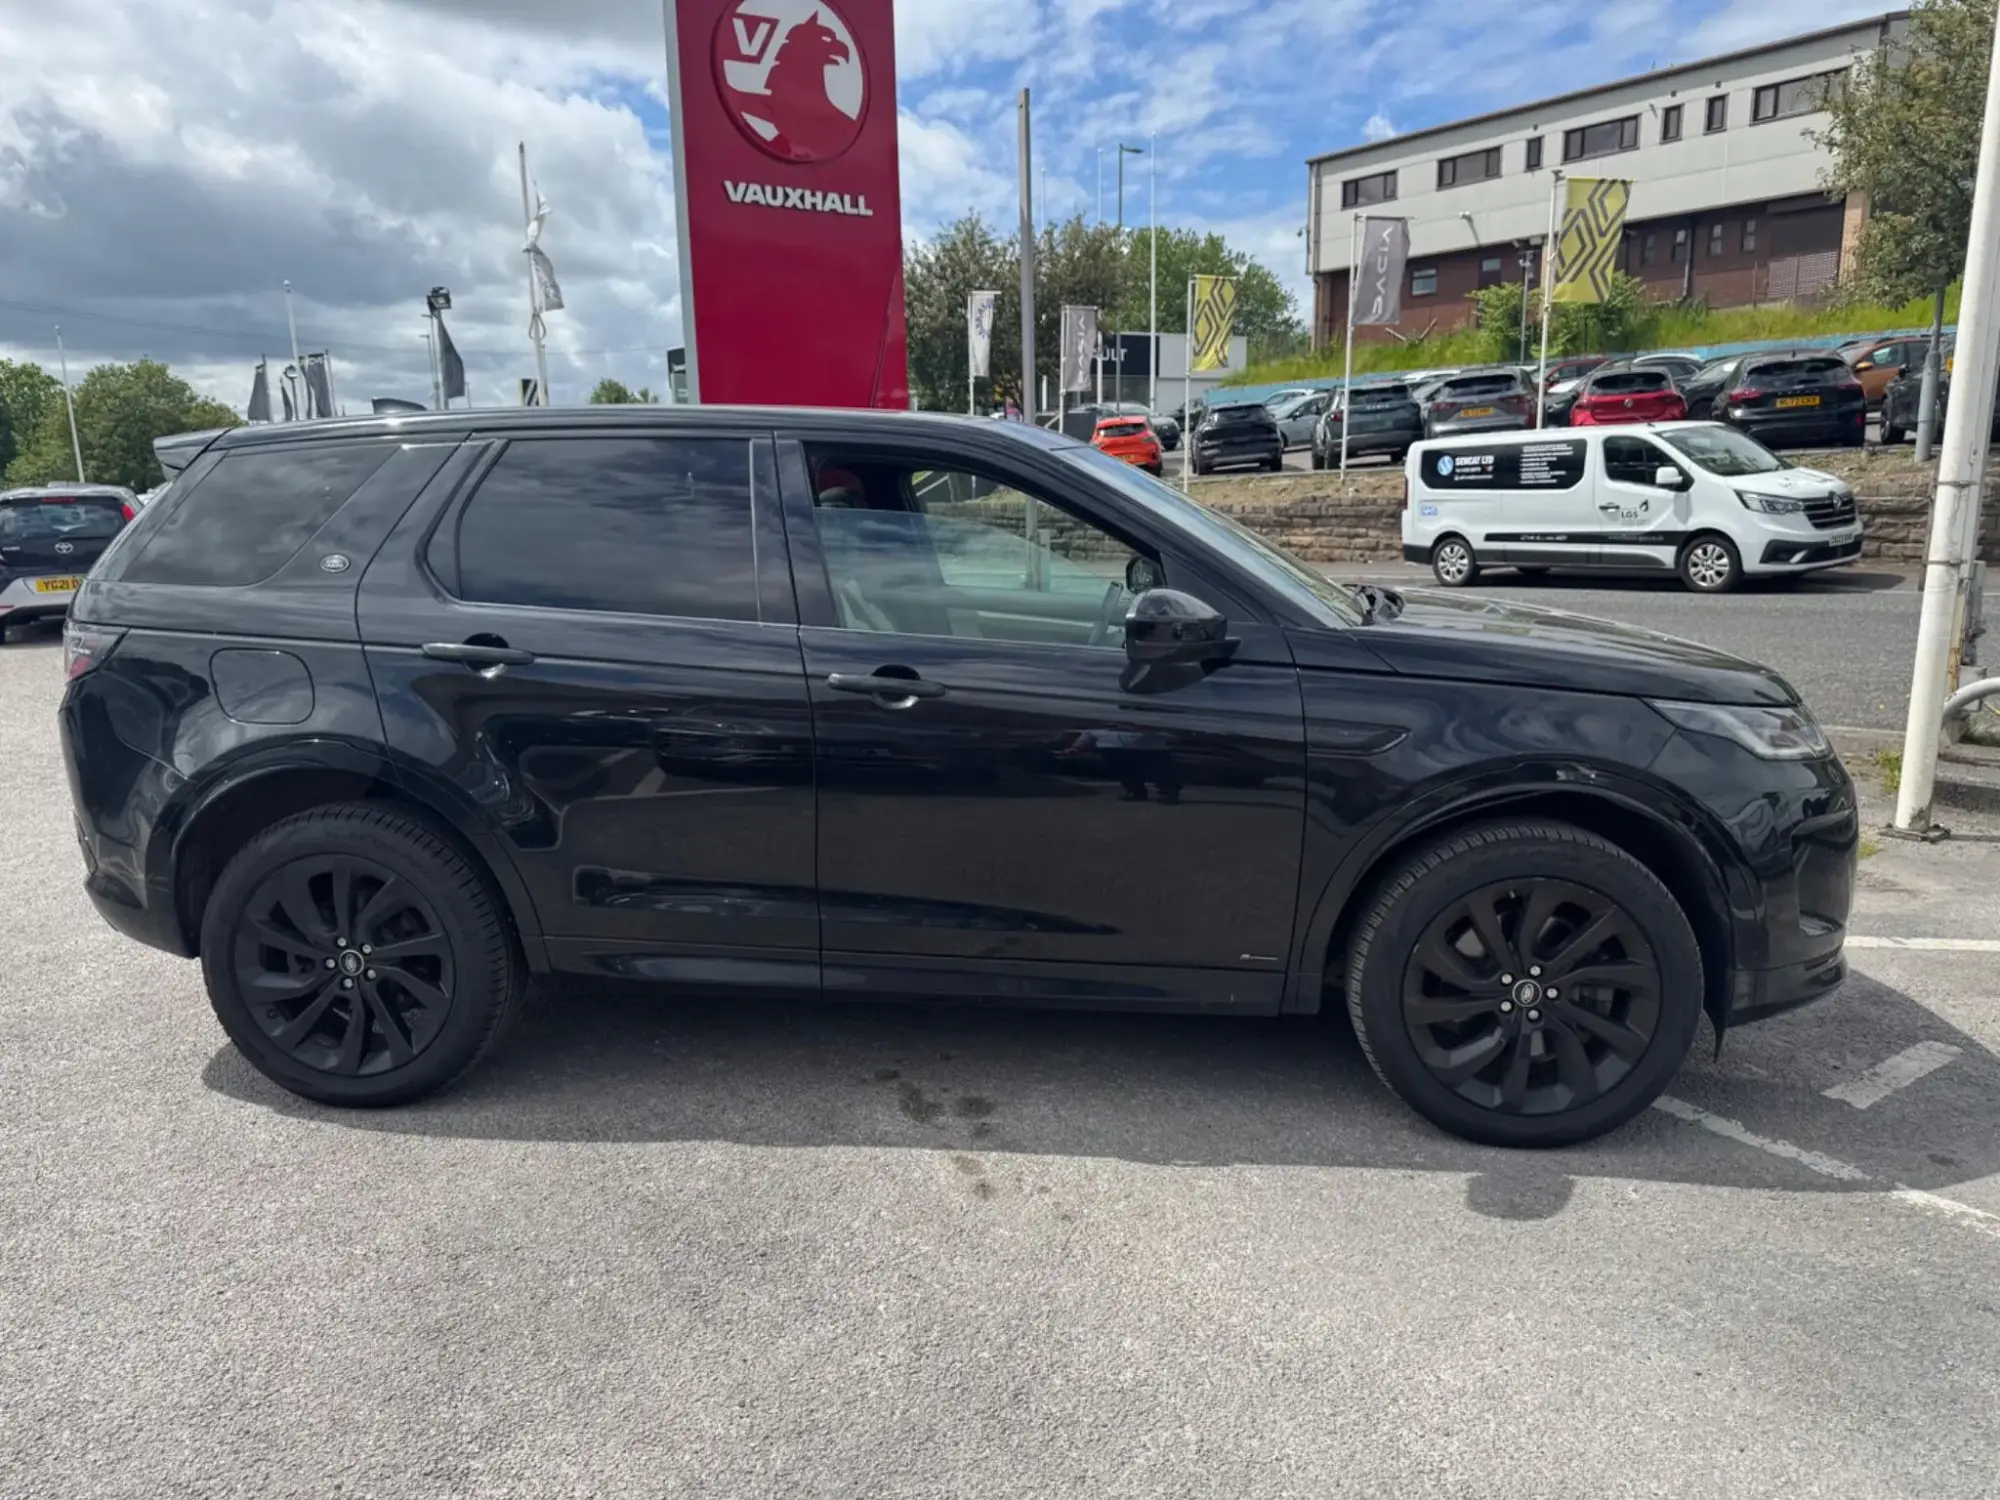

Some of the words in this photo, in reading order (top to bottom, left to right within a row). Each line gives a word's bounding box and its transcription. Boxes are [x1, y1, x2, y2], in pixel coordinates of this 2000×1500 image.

[724, 180, 873, 217] VAUXHALL
[1372, 225, 1394, 315] DACIA
[43, 579, 70, 590] YG21
